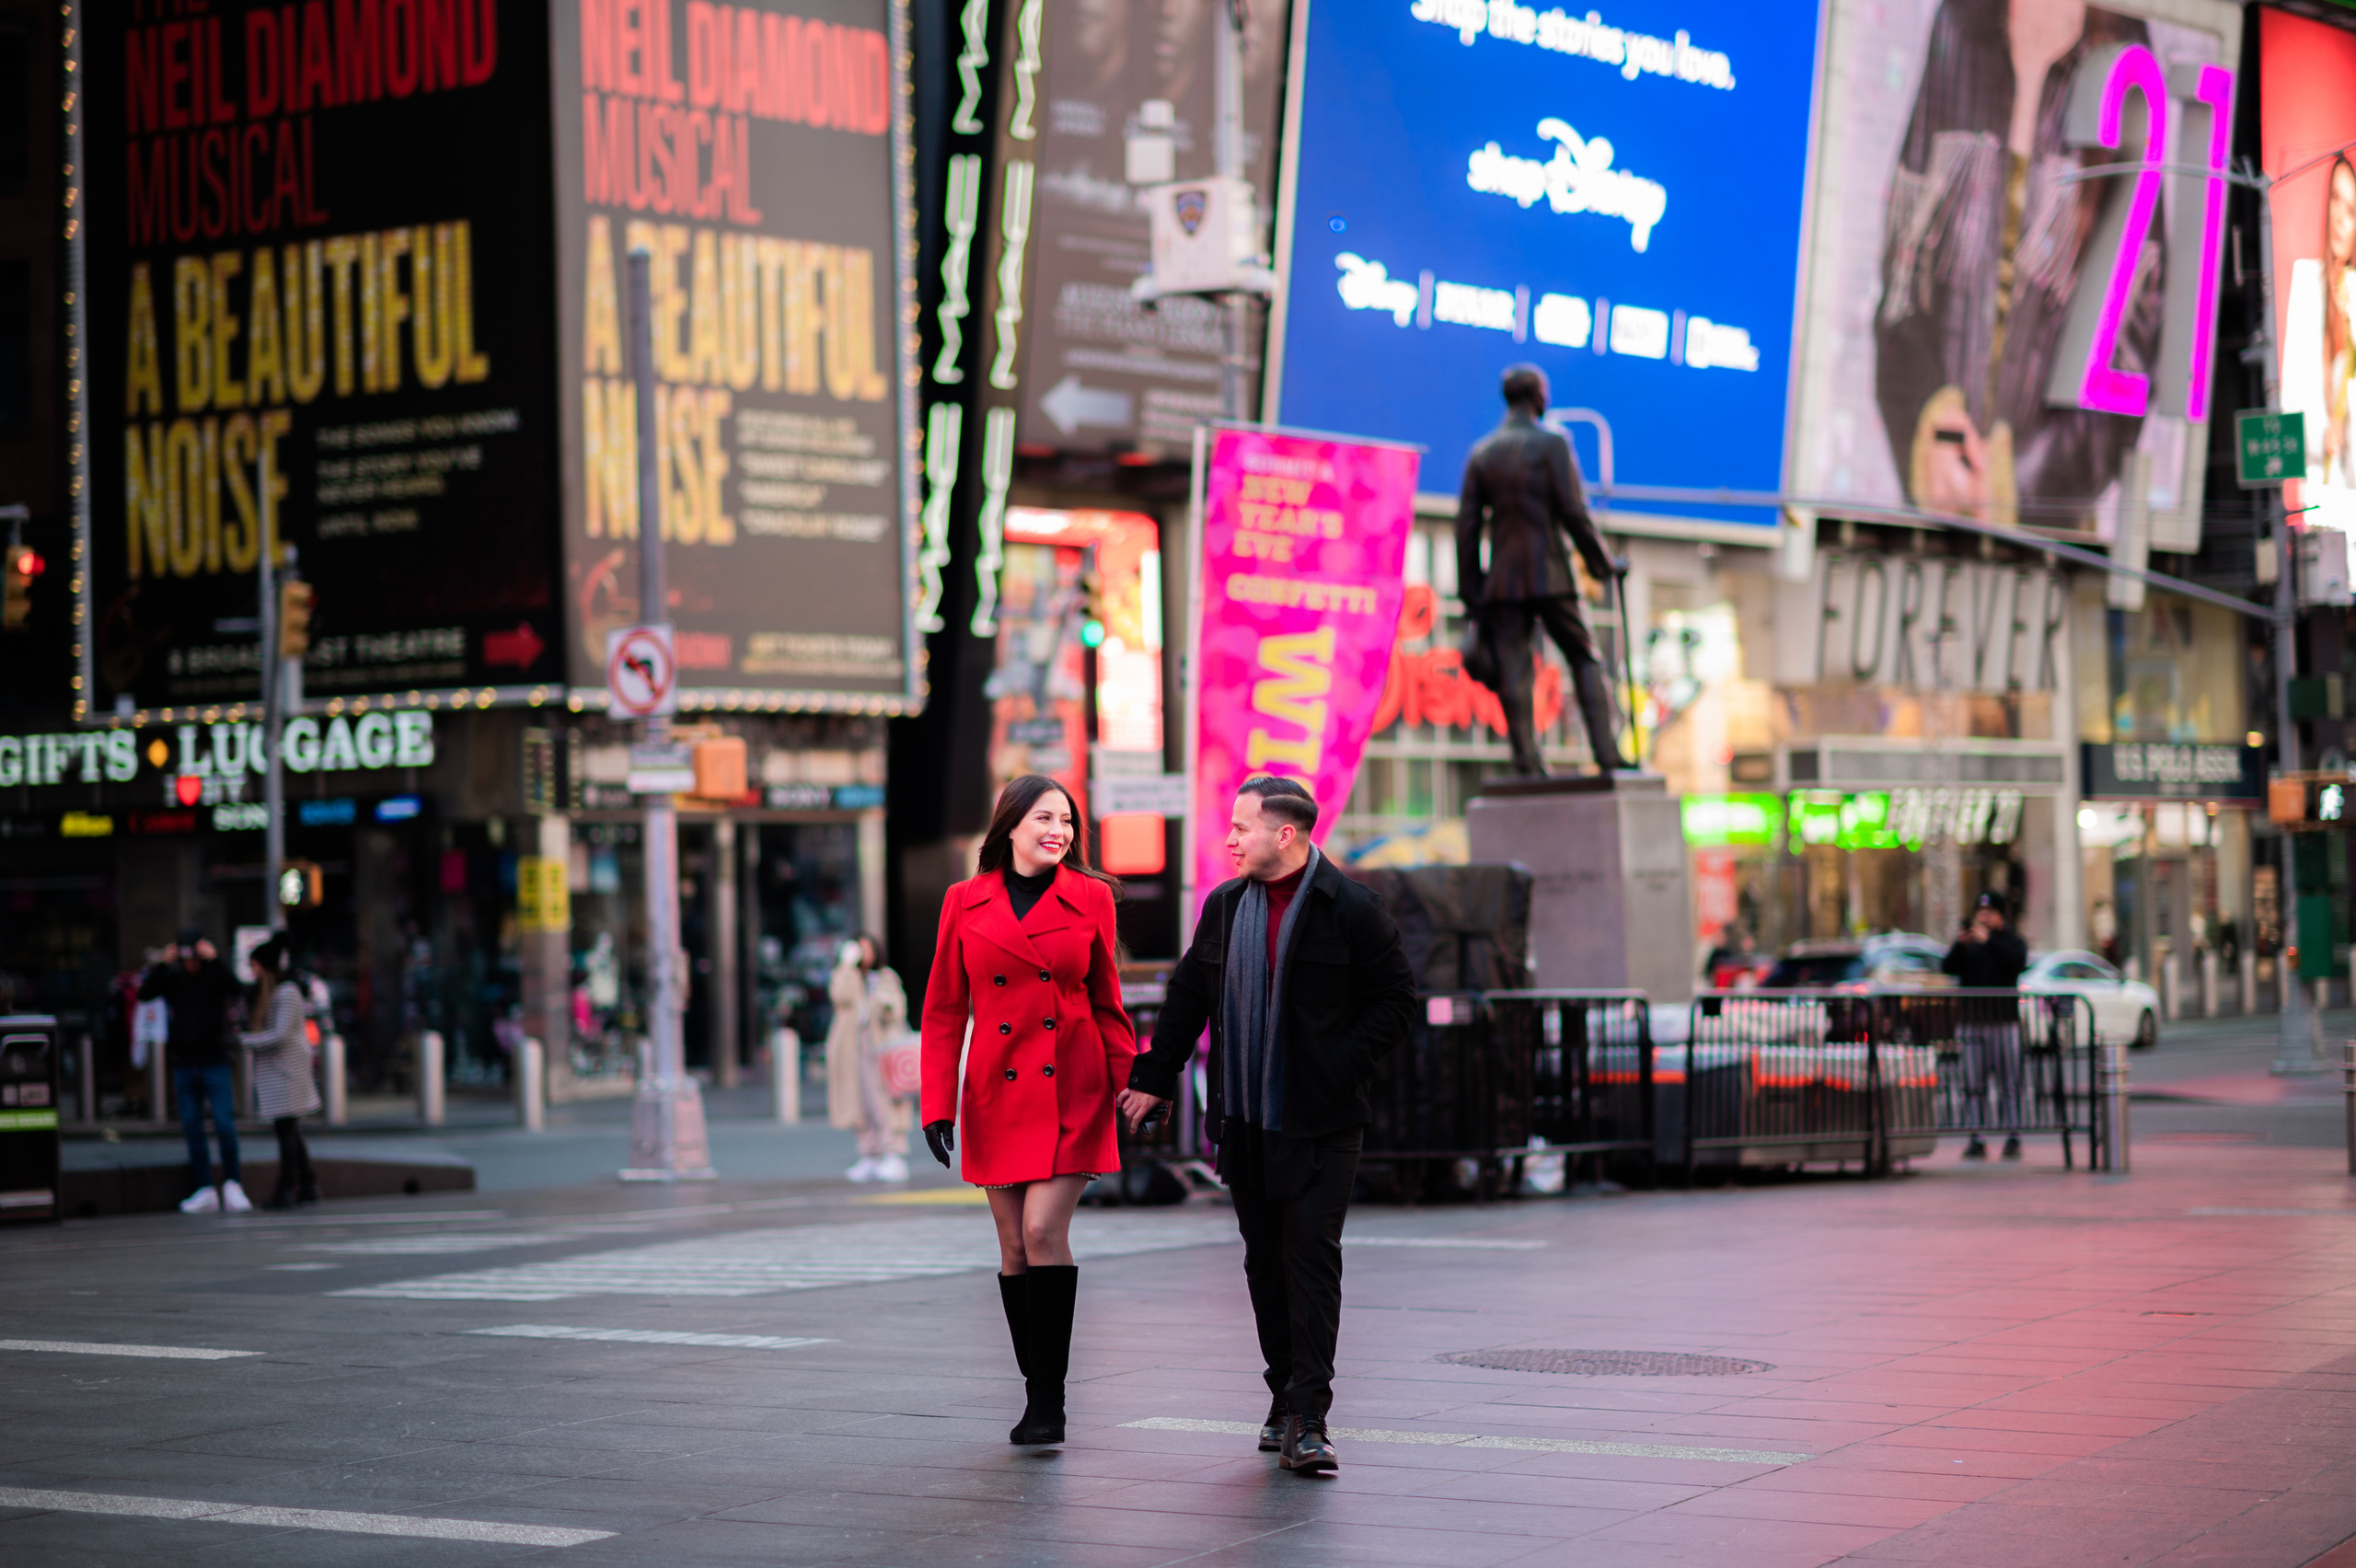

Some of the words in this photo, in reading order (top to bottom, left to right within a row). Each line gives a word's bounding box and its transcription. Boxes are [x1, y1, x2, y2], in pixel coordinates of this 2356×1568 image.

[125, 17, 237, 135] NEIL
[246, 0, 498, 118] DIAMOND
[580, 0, 684, 105] NEIL
[686, 0, 890, 136] DIAMOND
[127, 117, 329, 247] MUSICAL
[583, 92, 764, 225] MUSICAL
[583, 214, 623, 374] A
[2078, 42, 2234, 423] 21
[125, 261, 163, 417] A
[174, 218, 490, 414] BEAUTIFUL
[125, 409, 294, 578] NOISE
[1231, 529, 1294, 563] EVE
[1241, 473, 1313, 506] NEW
[1226, 572, 1379, 615] CONFETTI
[1813, 550, 2066, 692] FOREVER
[0, 726, 138, 787] GIFTS
[1244, 626, 1336, 794] WI
